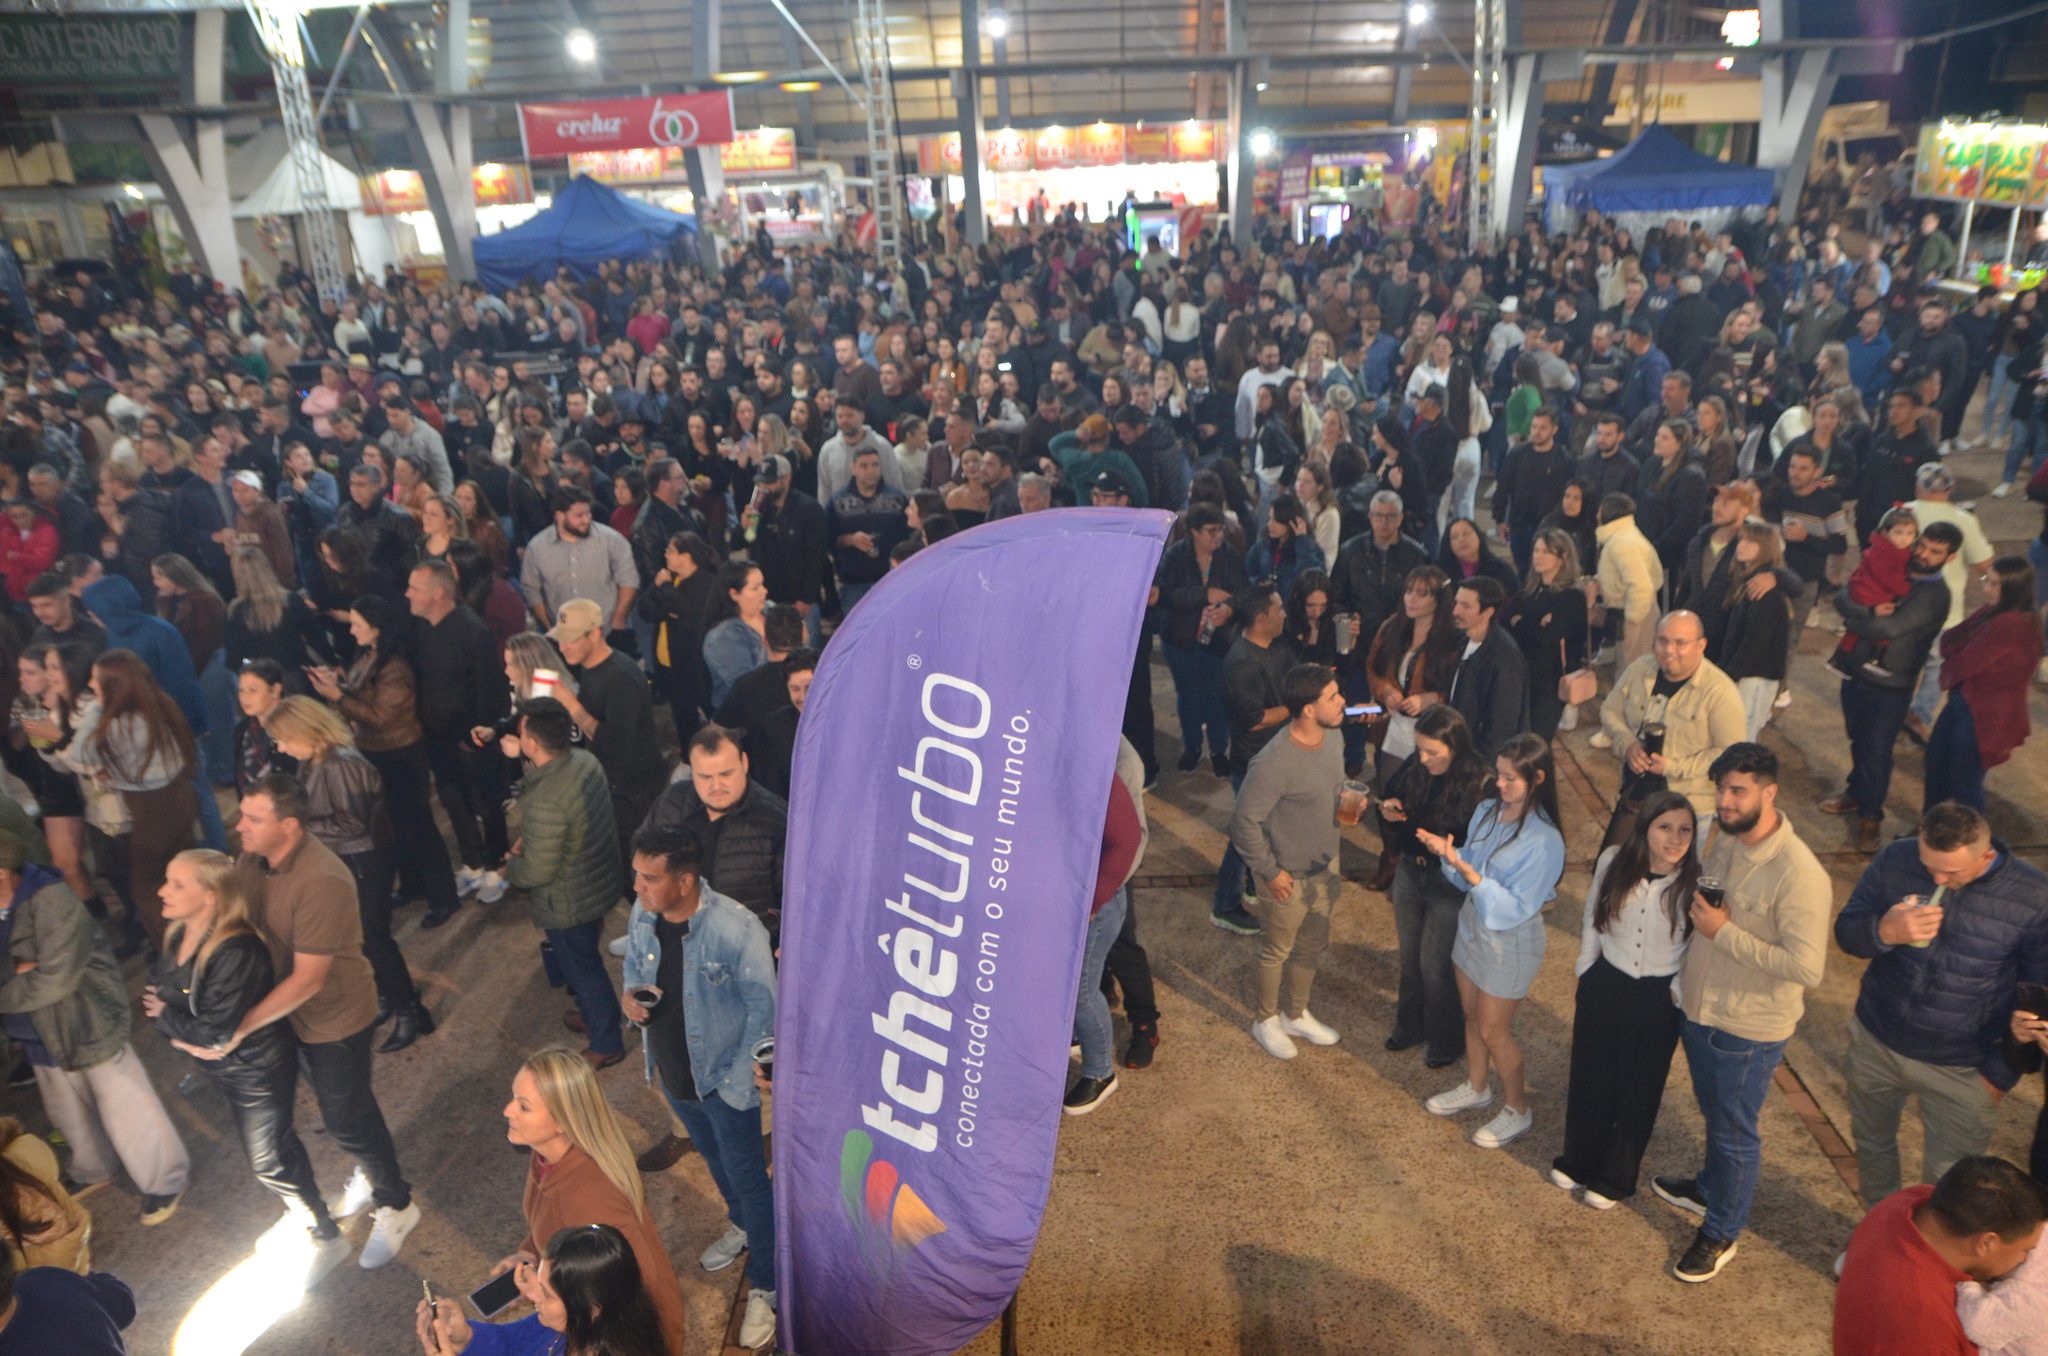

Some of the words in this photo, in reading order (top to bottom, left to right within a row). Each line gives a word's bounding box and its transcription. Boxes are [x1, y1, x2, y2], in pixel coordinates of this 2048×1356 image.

[556, 113, 621, 138] creluz
[997, 708, 1032, 826] mundo.
[988, 838, 1013, 892] seu
[985, 901, 1003, 920] o
[975, 931, 1000, 993] com
[956, 1002, 991, 1149] conectada
